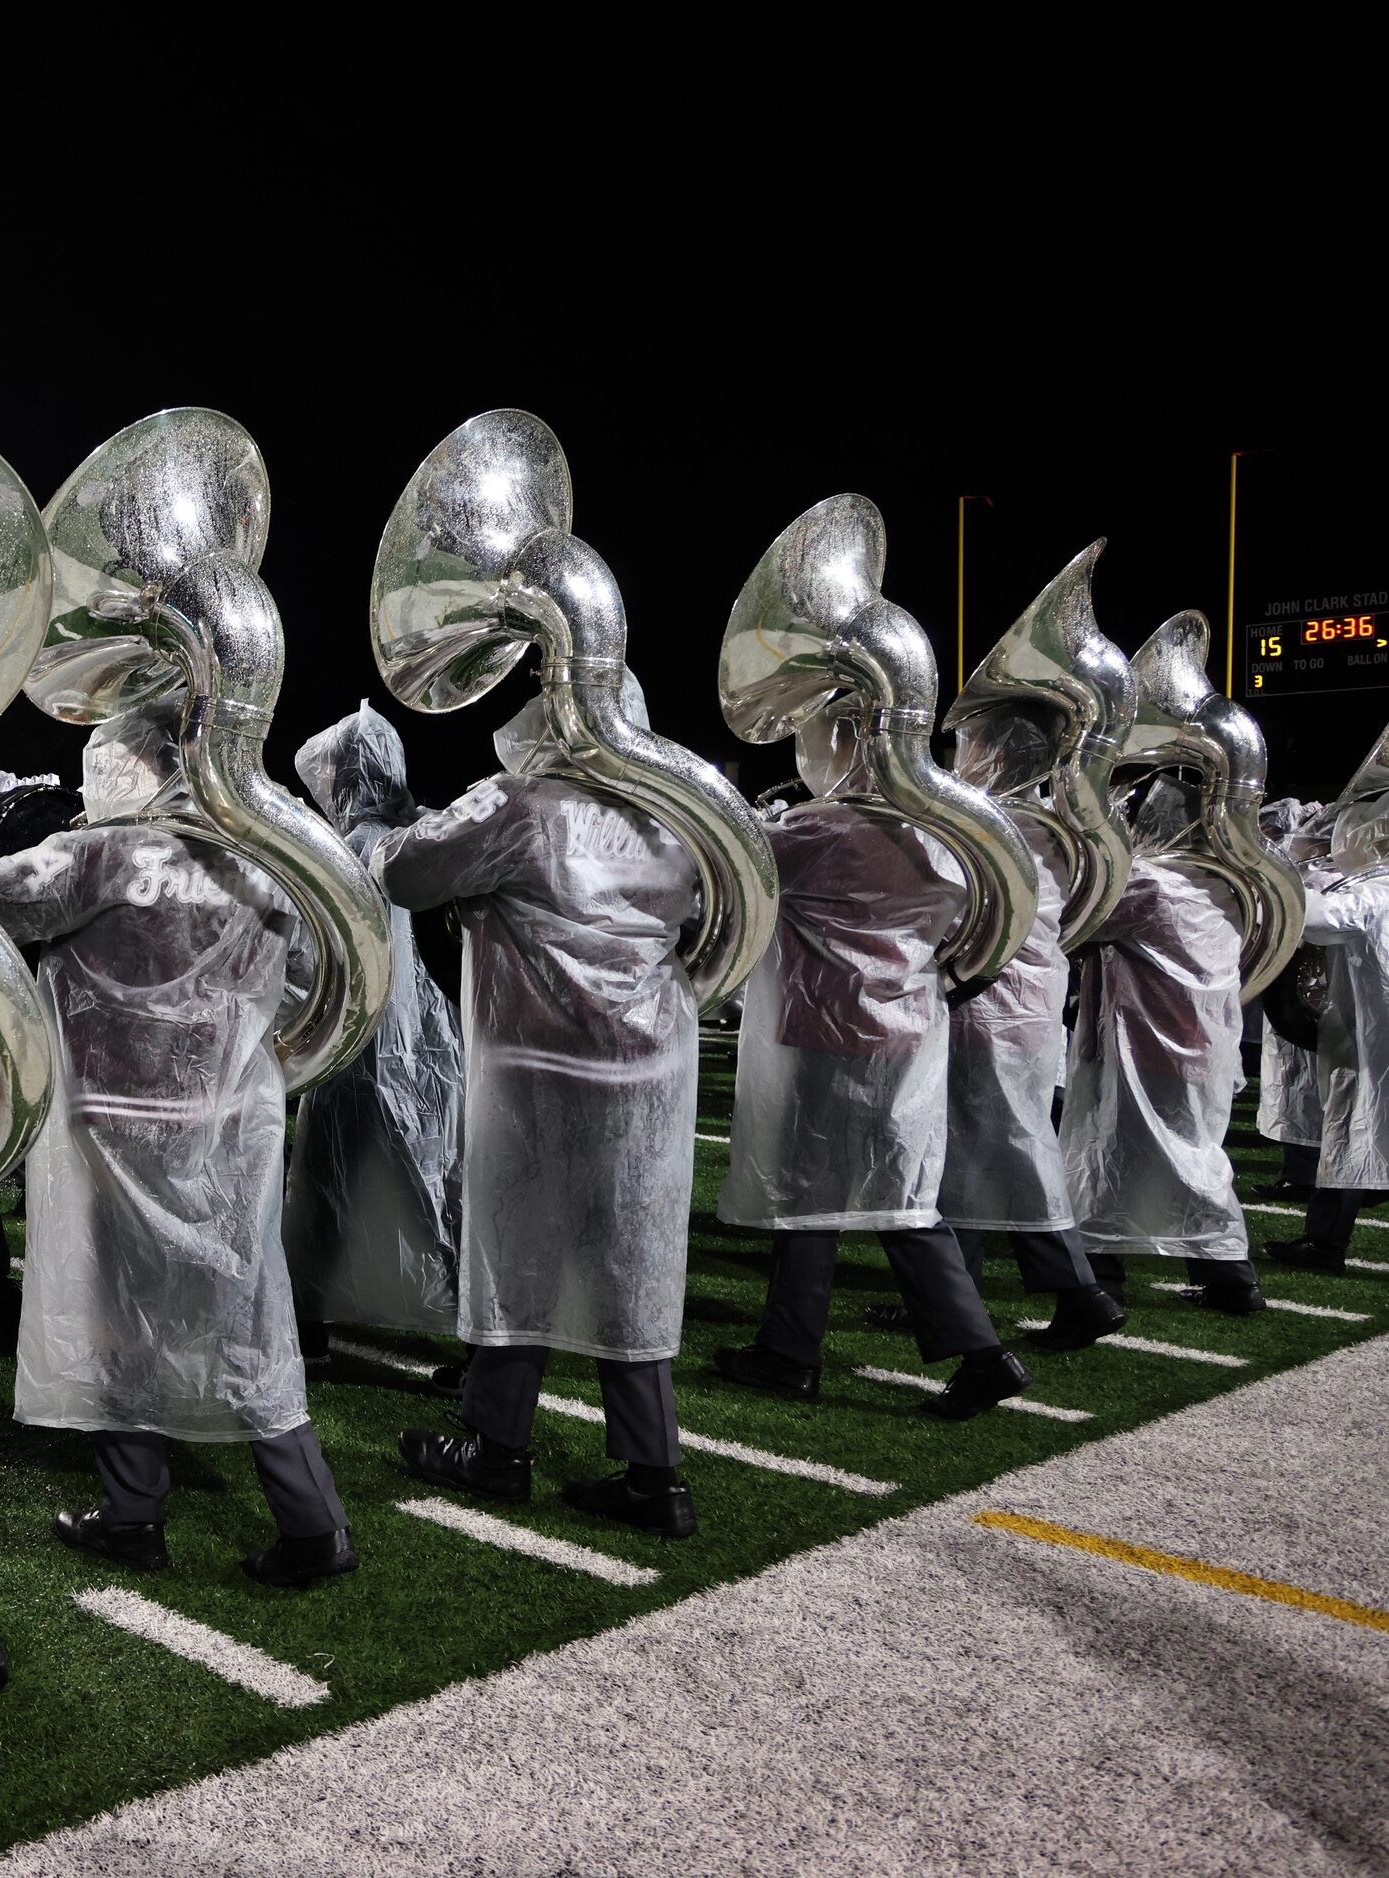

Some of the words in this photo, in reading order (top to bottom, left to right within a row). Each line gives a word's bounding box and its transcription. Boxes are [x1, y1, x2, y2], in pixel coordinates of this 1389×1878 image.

[1265, 600, 1300, 616] JOHN
[1305, 596, 1349, 611] CLARK
[1250, 625, 1283, 638] HOME
[1306, 616, 1373, 641] 26:36
[1261, 636, 1282, 657] 15
[1293, 659, 1307, 670] TO
[1309, 657, 1325, 669] GO
[1347, 655, 1372, 666] BALL
[1374, 652, 1389, 664] ON
[1252, 661, 1283, 673] DOWN
[1254, 675, 1264, 688] 3
